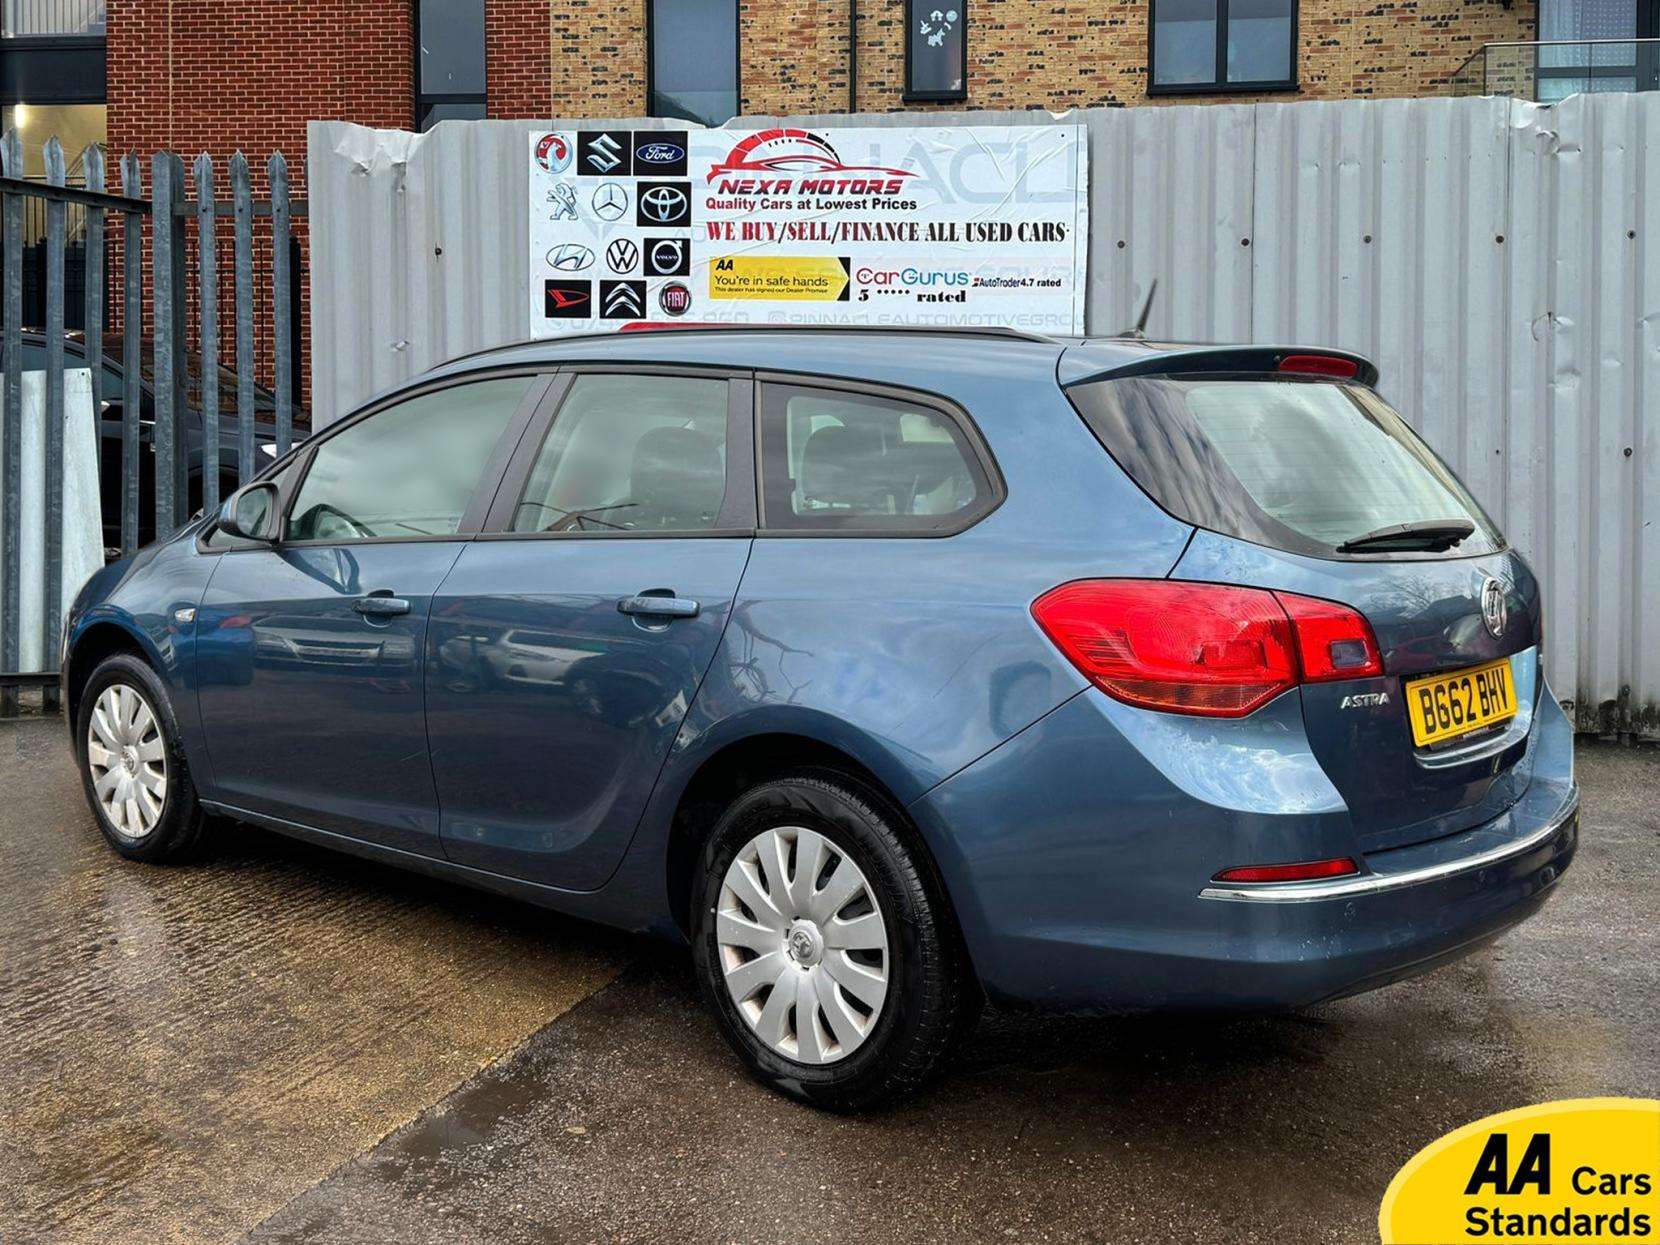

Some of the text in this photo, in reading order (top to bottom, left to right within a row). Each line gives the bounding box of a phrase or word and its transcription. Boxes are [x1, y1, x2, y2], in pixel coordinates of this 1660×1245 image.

[645, 145, 675, 160] Ford
[718, 179, 903, 195] NEXA MOTORS
[706, 197, 917, 212] Quality Cars at Lowest Prices
[706, 221, 735, 241] WE
[742, 221, 919, 244] BUY/SELL/FINANCE
[925, 222, 959, 242] ALL
[965, 222, 1013, 242] USED
[715, 259, 734, 271] AA
[714, 275, 829, 287] You're in safe hands
[856, 267, 969, 286] CarGurus
[1037, 278, 1062, 287] rated
[667, 291, 686, 307] FIAT
[858, 289, 967, 303] 5 rated
[1340, 692, 1390, 709] ASTRA
[1419, 668, 1508, 735] BG62 BHV
